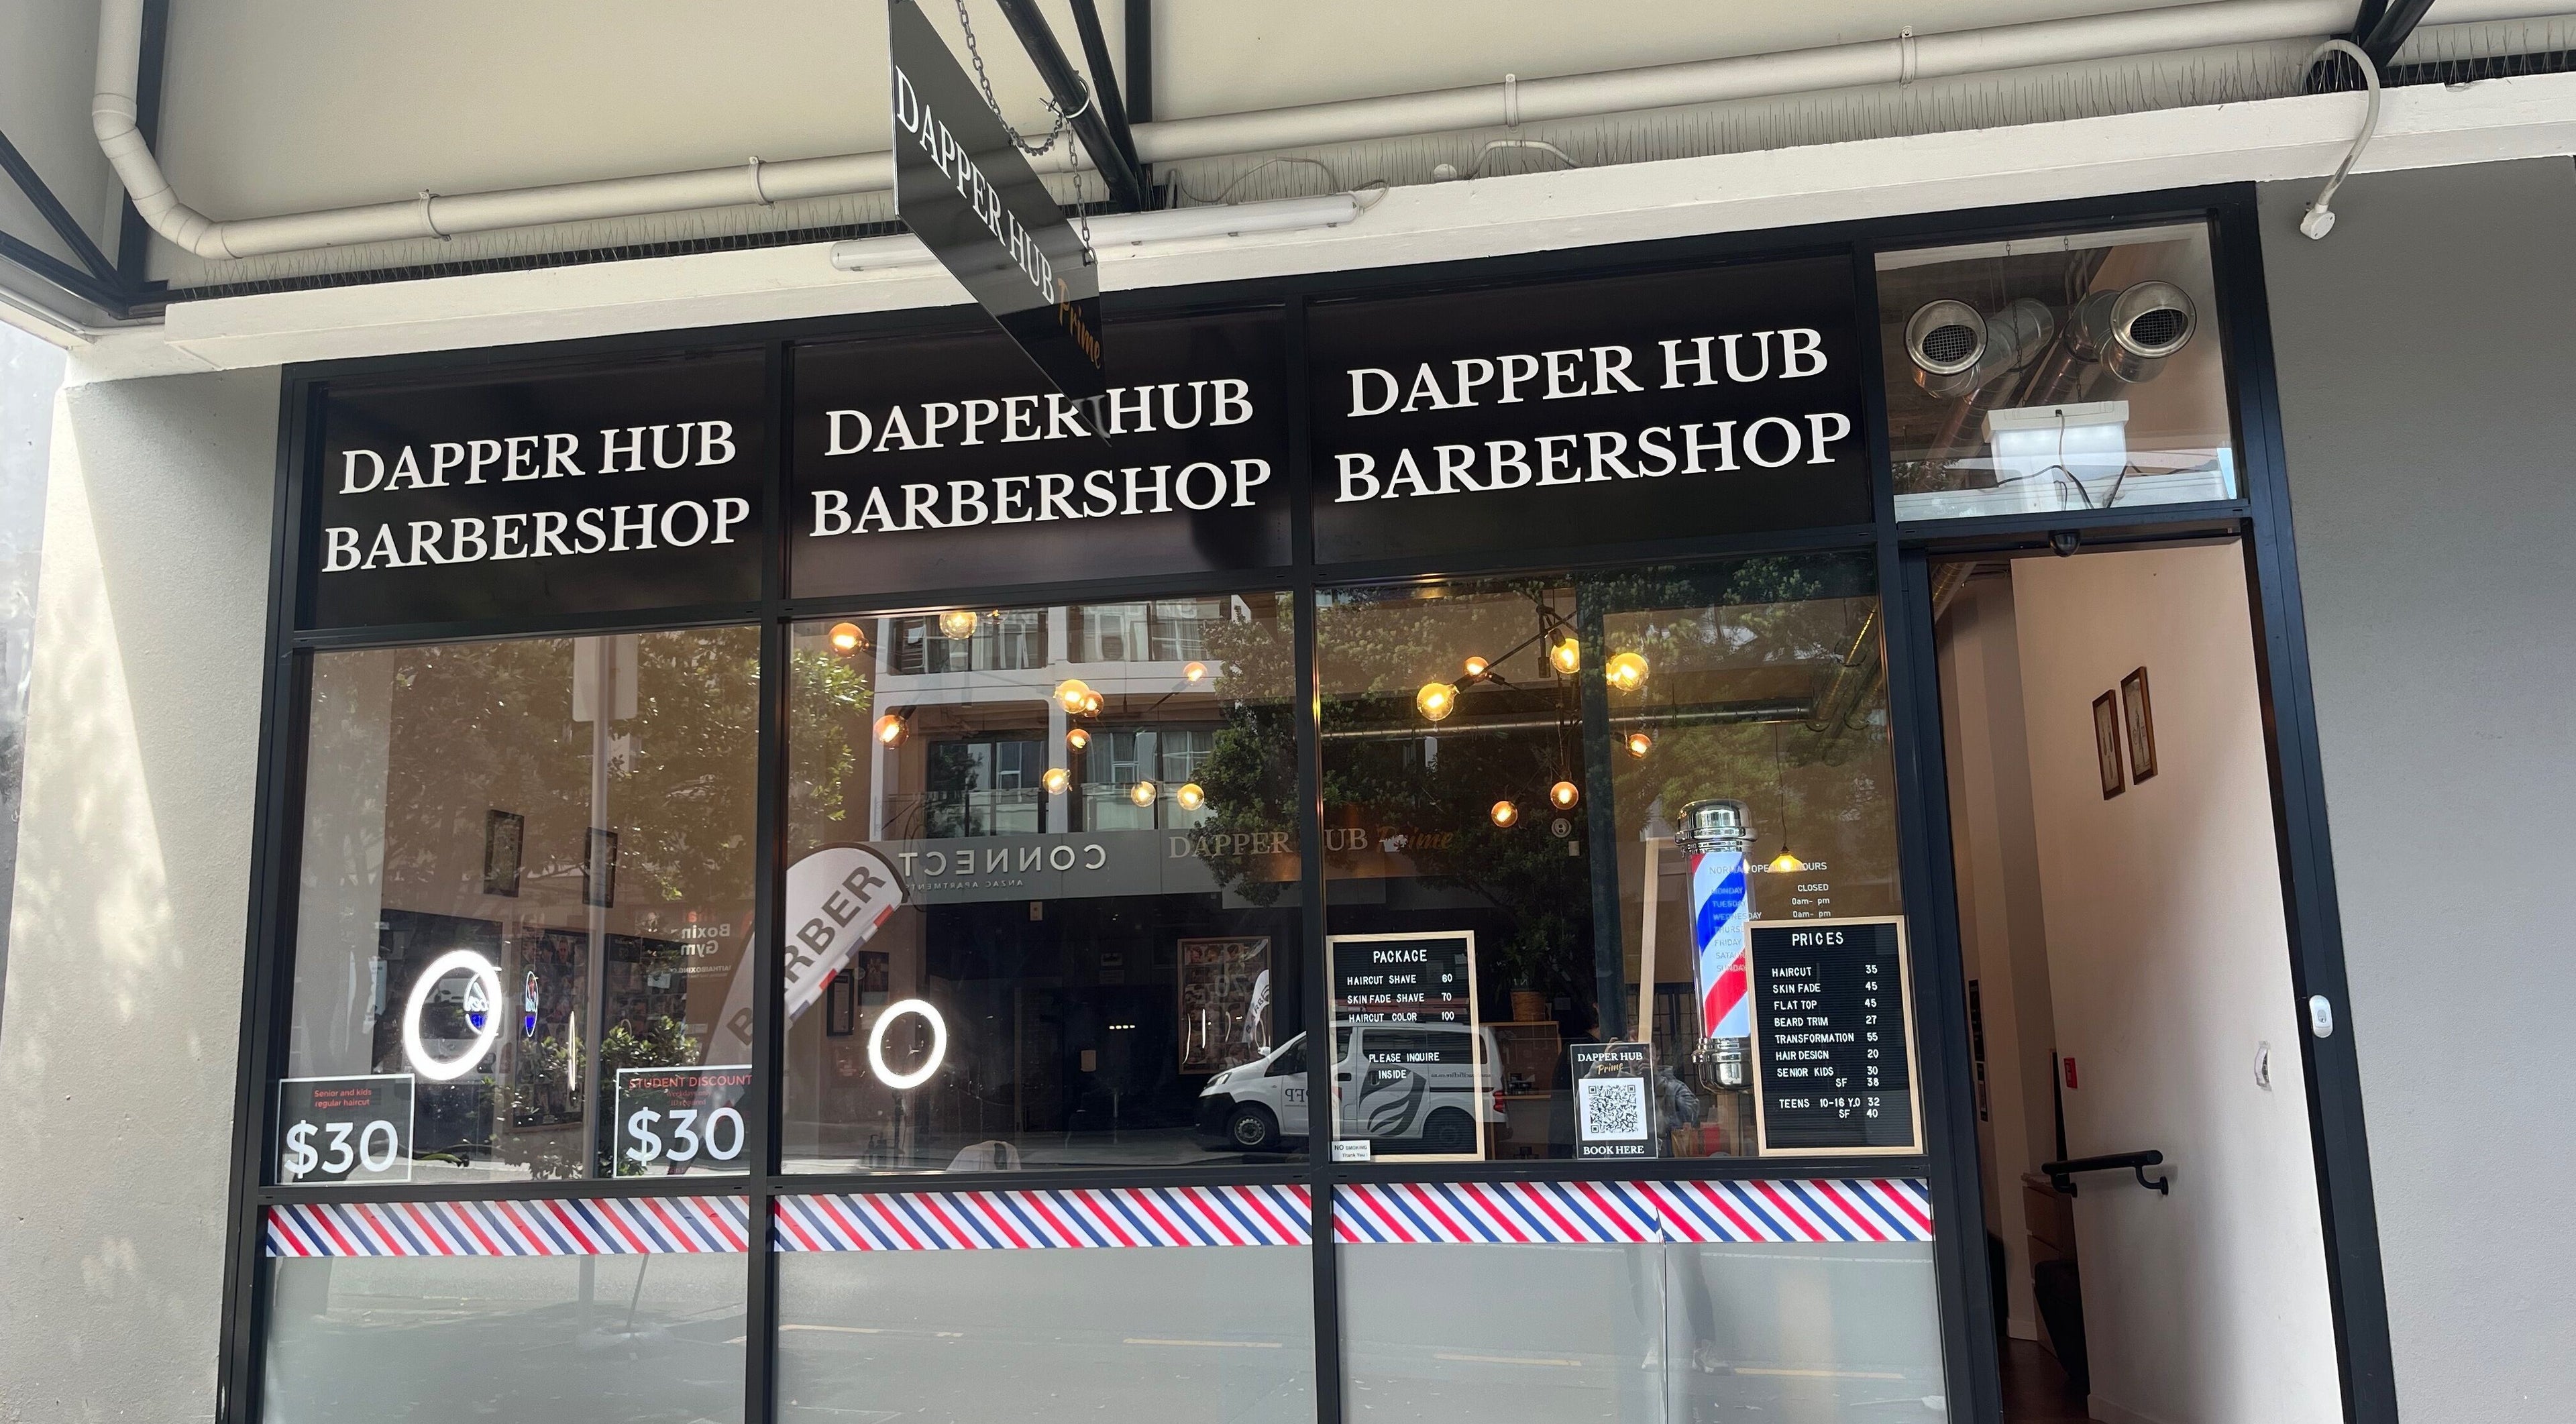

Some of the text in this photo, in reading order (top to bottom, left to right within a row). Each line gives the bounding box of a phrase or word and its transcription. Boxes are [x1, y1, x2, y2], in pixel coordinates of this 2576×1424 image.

[896, 66, 1055, 305] DAPPER HUB
[1057, 278, 1102, 370] Prime
[1346, 328, 1828, 417] DAPPER HUB
[824, 379, 1254, 456] DAPPER HUB
[339, 421, 736, 494] DAPPER HUB
[1334, 413, 1851, 503] BARBERSHOP
[810, 459, 1271, 537] BARBERSHOP
[322, 498, 749, 572] BARBERSHOP
[1169, 828, 1368, 859] DAPPER UB
[1709, 867, 1750, 875] NORMA
[1798, 862, 1827, 871] OURS
[1713, 912, 1762, 920] WEDNESDAY
[1792, 932, 1843, 946] PRICES
[727, 866, 885, 1046] BRBER
[1373, 950, 1428, 963] PACKAGE
[1772, 965, 1878, 977] HAIRCUT 35
[1347, 976, 1383, 985] HAIRCUT
[1389, 975, 1417, 984] SHAVE
[1773, 982, 1877, 993] SKIN FADE 45
[1348, 993, 1452, 1003] SKIN FADE SHAVE 70
[1774, 999, 1877, 1009] FLAT TOP 45
[1349, 1012, 1454, 1023] HAIRCUT COLOR 100
[1774, 1016, 1877, 1026] BEARD TRIM 27
[1775, 1033, 1878, 1044] TRANSFORMATION 55
[1369, 1052, 1440, 1062] PLEASE INQUIRE
[1578, 1052, 1643, 1062] DAPPER HUB
[1776, 1050, 1879, 1060] HAIR DESIGN 20
[1597, 1062, 1623, 1075] Prime
[1777, 1066, 1878, 1077] SENIOR KIDS 30
[1379, 1071, 1407, 1079] INSIDE
[629, 1075, 752, 1091] STUDENT DISCOUNT
[1836, 1078, 1879, 1087] SF 38
[315, 1101, 341, 1109] regular
[1779, 1099, 1810, 1108] TEENS
[1868, 1097, 1880, 1106] 32
[1839, 1109, 1878, 1118] SF 40
[626, 1107, 745, 1166] $30
[284, 1120, 398, 1179] $30
[1584, 1146, 1644, 1155] BOOK HERE
